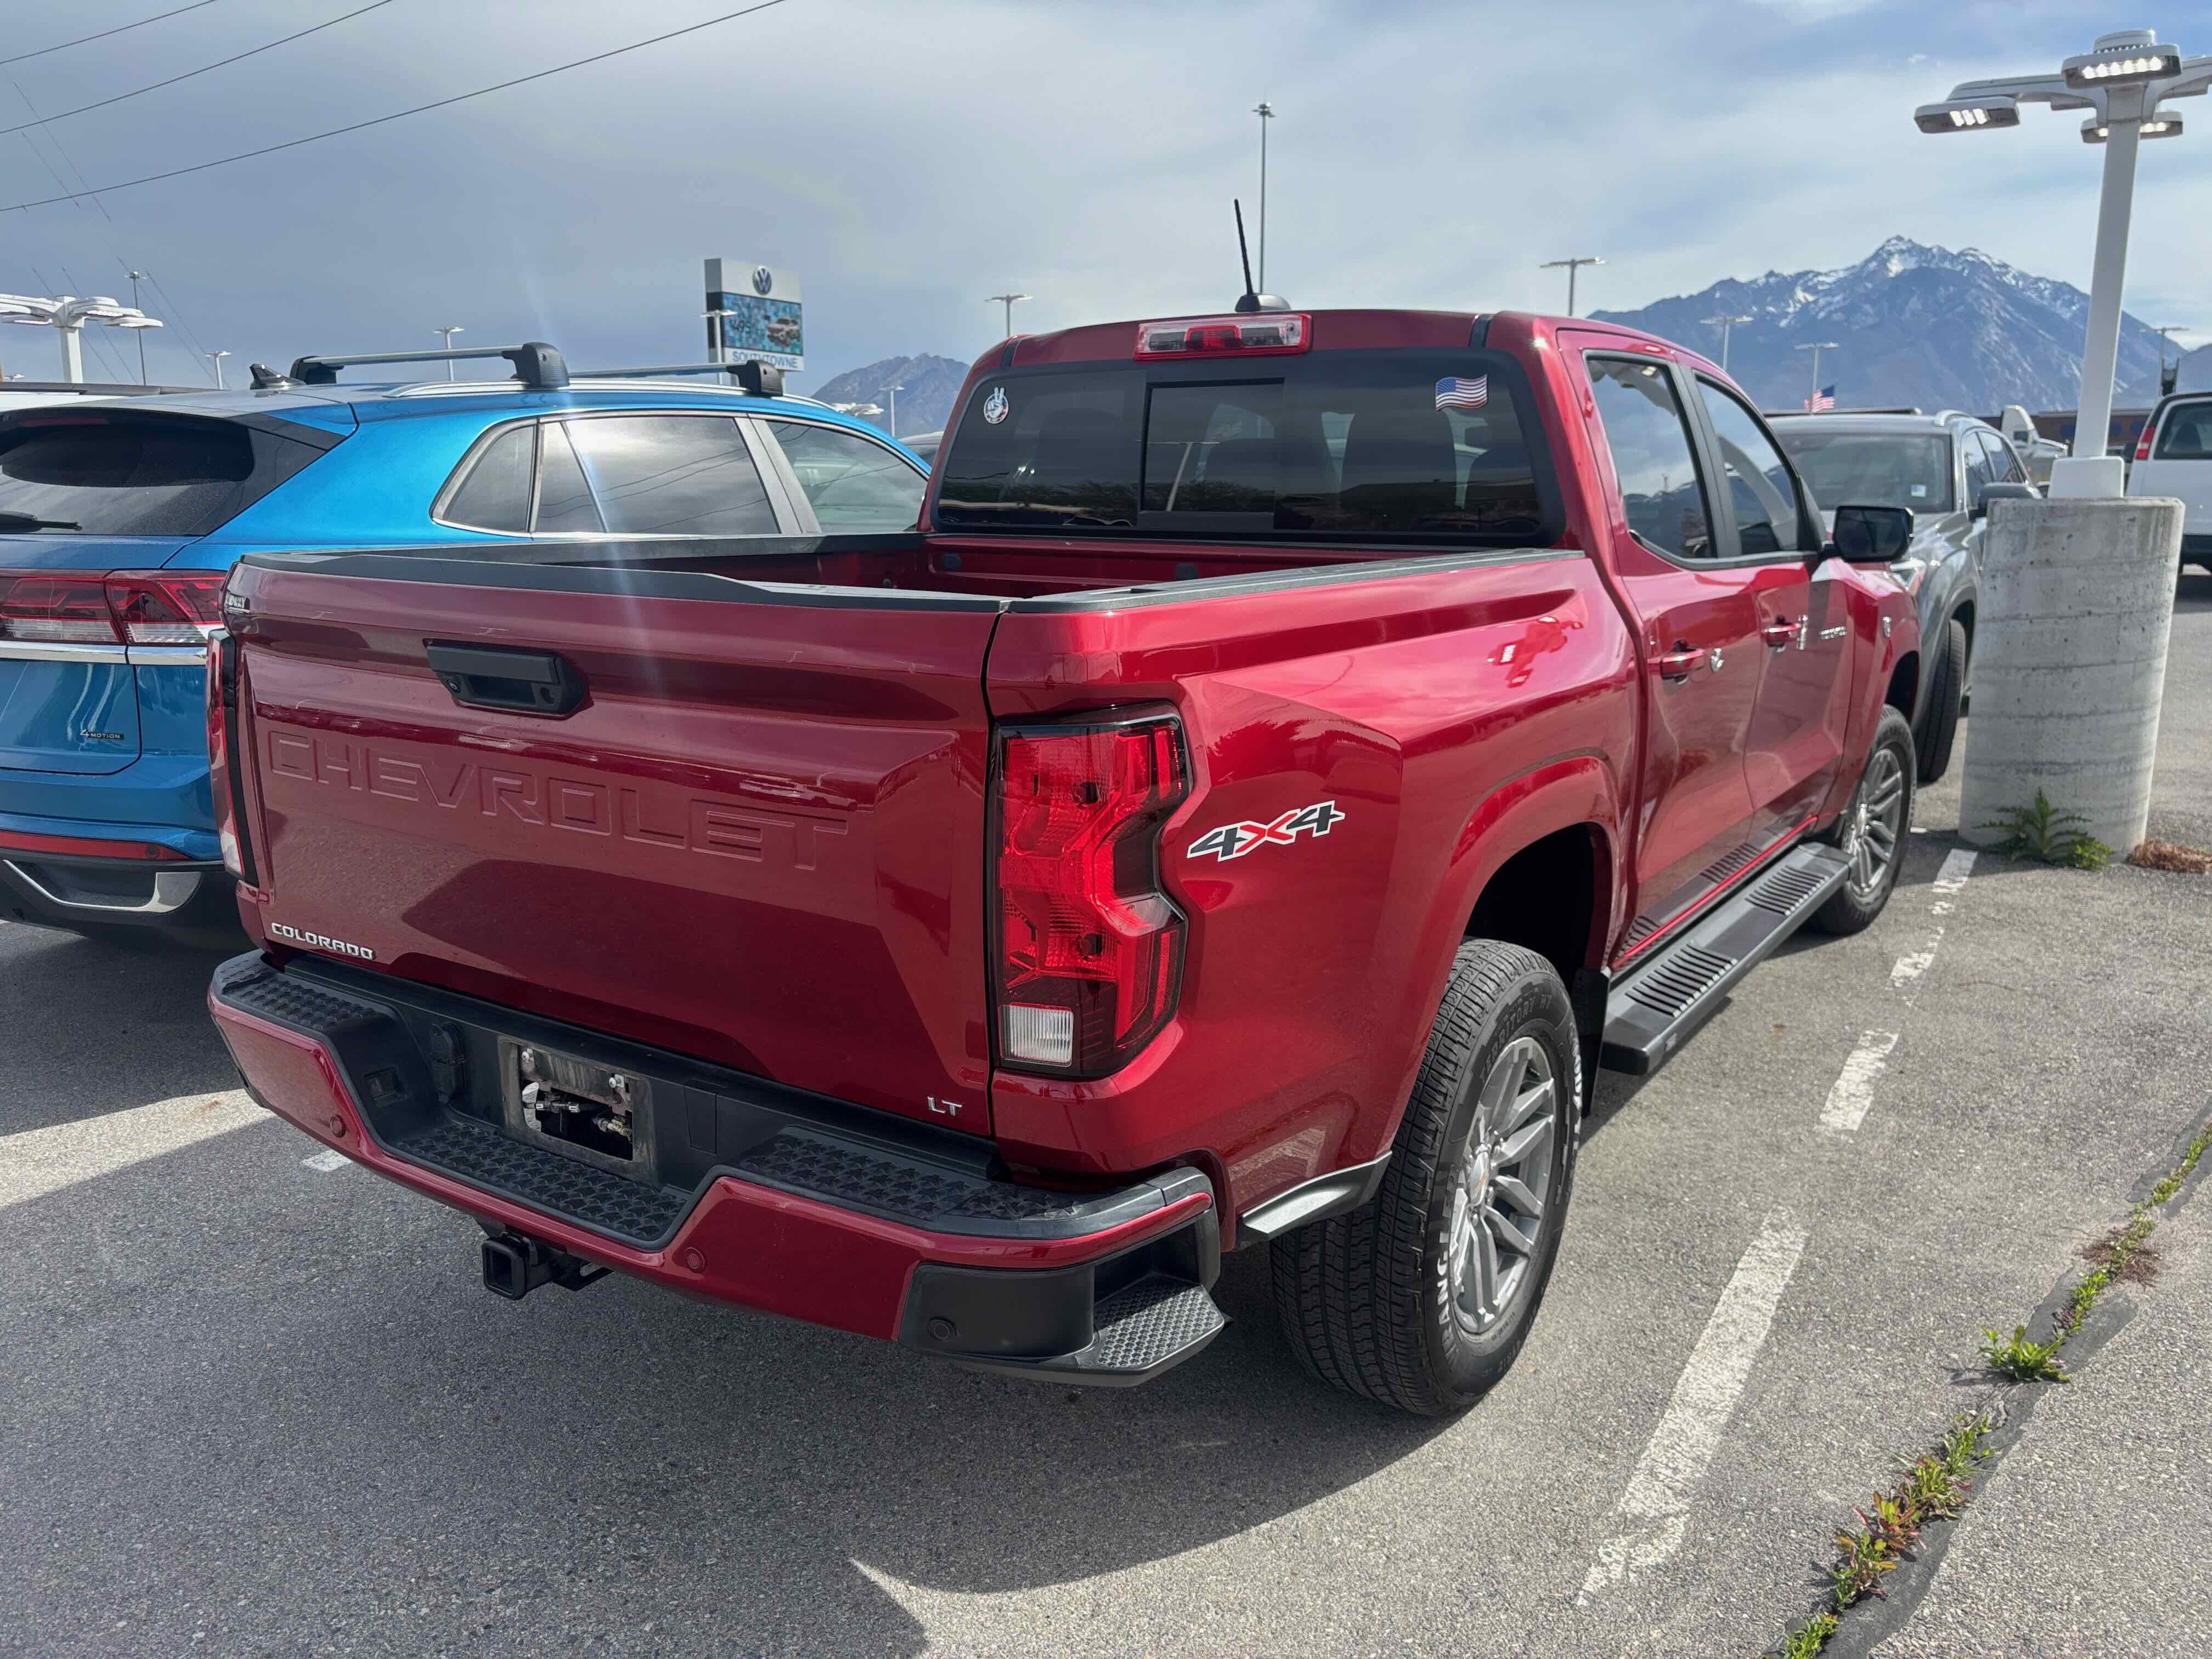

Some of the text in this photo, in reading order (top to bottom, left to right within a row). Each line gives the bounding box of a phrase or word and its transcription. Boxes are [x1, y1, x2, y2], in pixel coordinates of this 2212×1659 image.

[80, 729, 120, 738] 4MOTION
[268, 730, 848, 871] CHEVROLET
[272, 922, 373, 960] COLORADO
[927, 1096, 962, 1116] LT
